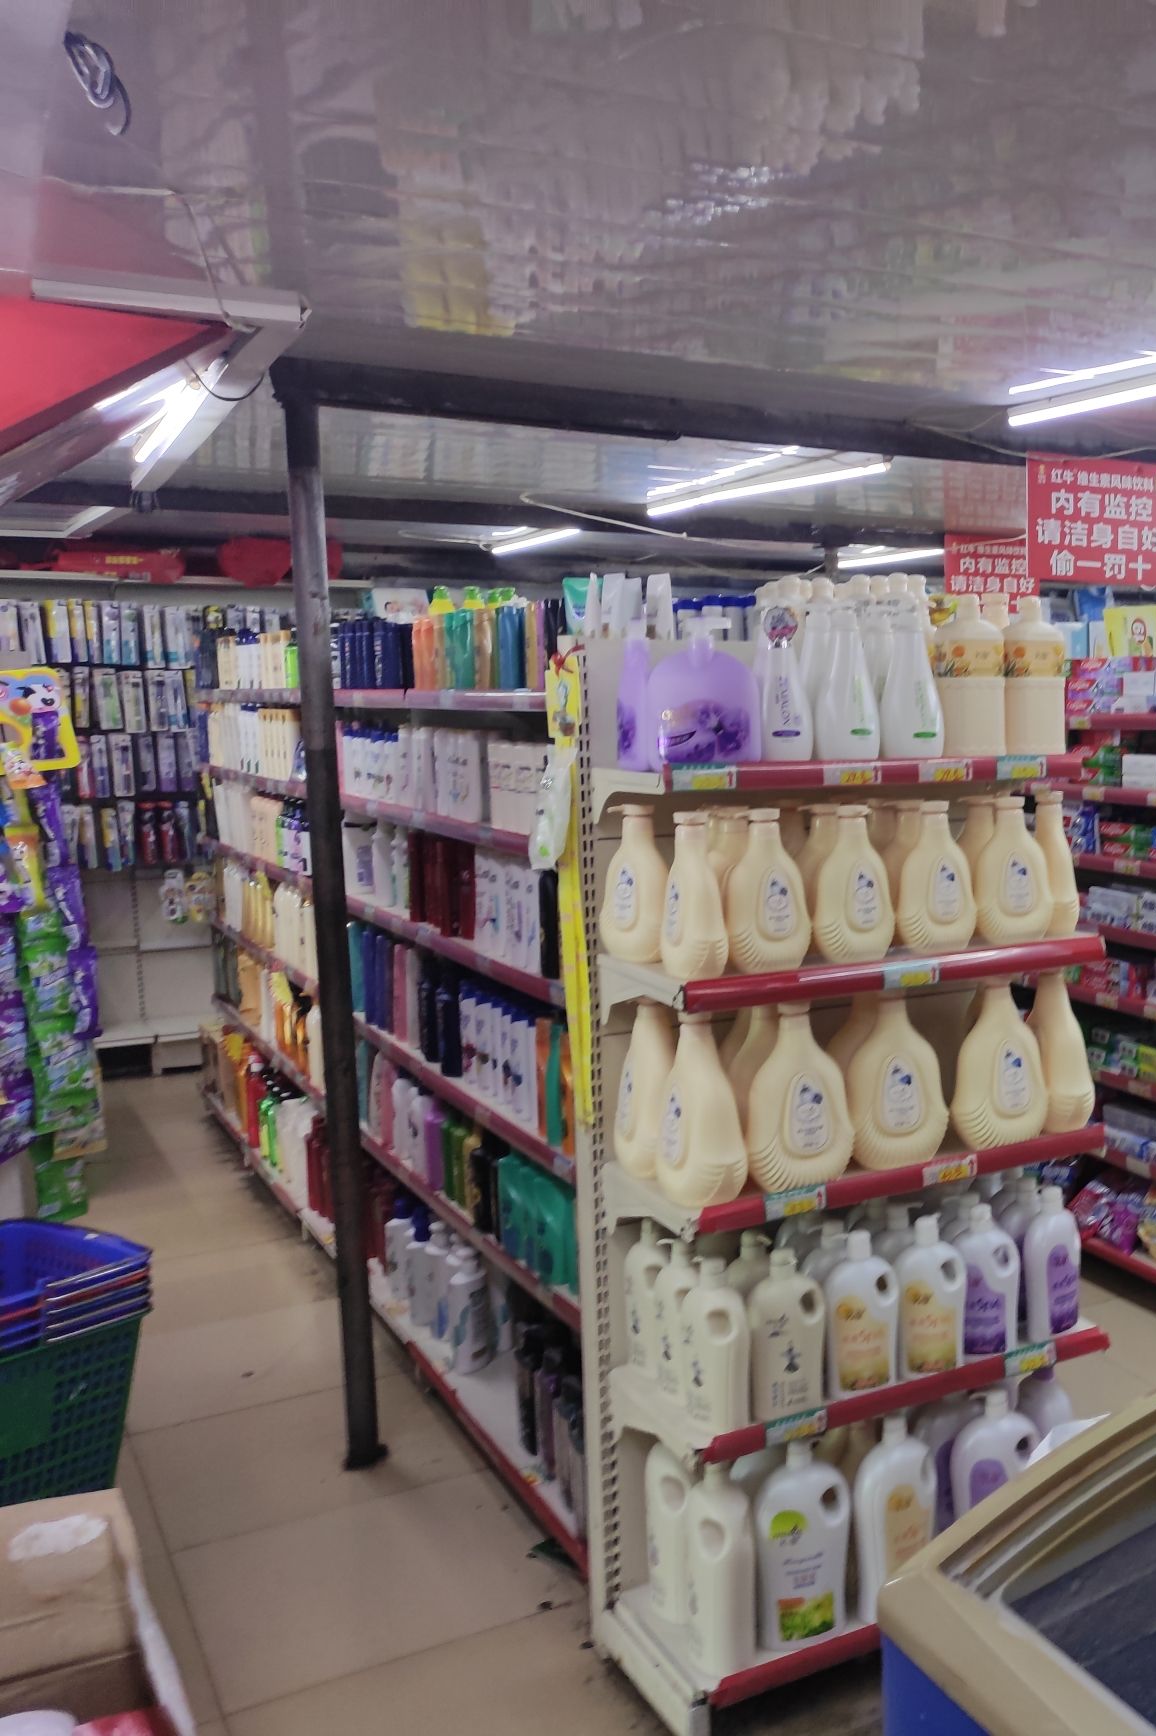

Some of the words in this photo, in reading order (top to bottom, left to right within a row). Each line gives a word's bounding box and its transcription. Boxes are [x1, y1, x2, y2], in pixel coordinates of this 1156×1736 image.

[1051, 488, 1153, 522] 内有监控
[960, 556, 1027, 575] 内有监控
[1050, 549, 1152, 581] 偷一罚十
[950, 575, 1035, 593] 请洁身自好
